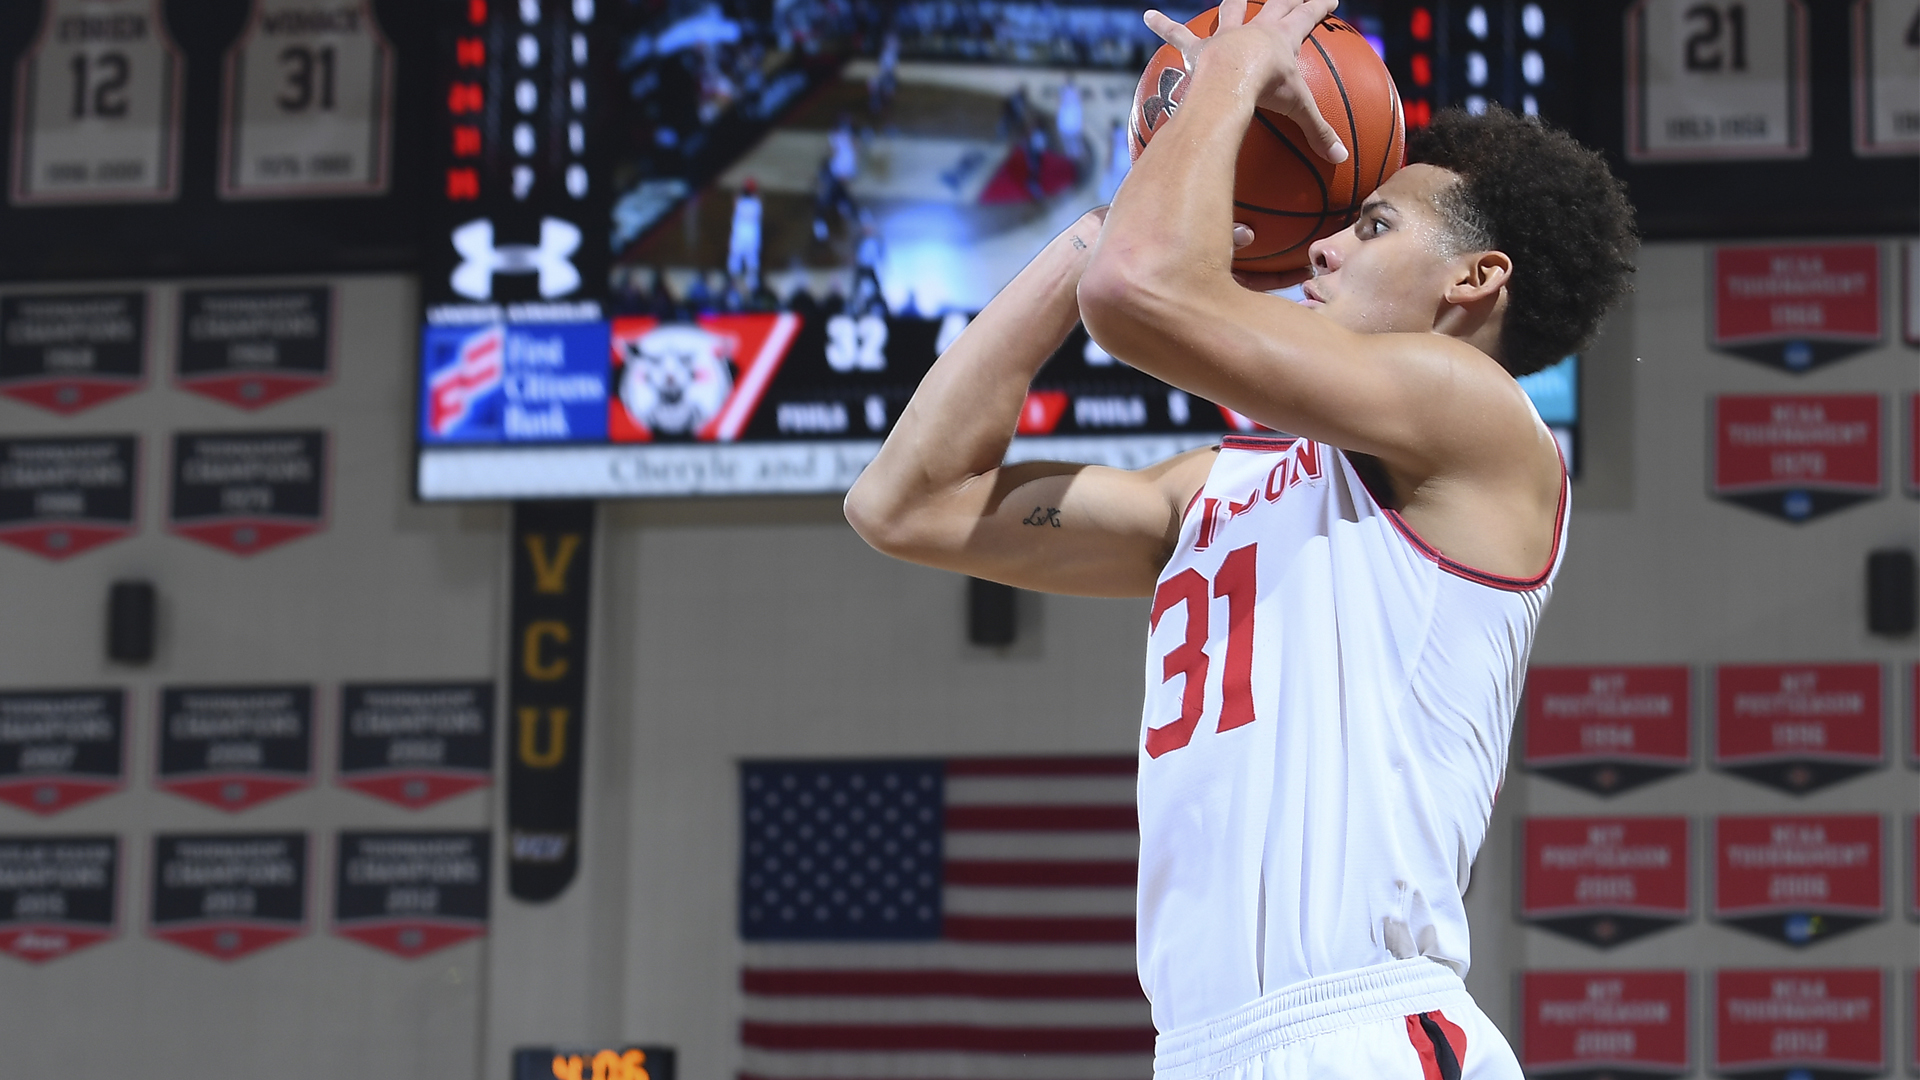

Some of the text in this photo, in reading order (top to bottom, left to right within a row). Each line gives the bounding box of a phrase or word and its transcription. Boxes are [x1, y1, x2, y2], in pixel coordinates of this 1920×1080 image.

[1684, 4, 1747, 74] 21
[70, 52, 130, 121] 12
[277, 46, 336, 112] 31
[512, 164, 535, 201] 7
[507, 334, 564, 366] First
[825, 315, 888, 372] 32
[505, 371, 604, 404] Citizens
[504, 404, 571, 437] Bank
[608, 453, 739, 492] Cheryle
[758, 452, 819, 482] and
[517, 533, 581, 769] VCU
[1144, 542, 1257, 760] 31
[1581, 725, 1635, 748] 1994
[1727, 844, 1870, 867] TOURNAMENT
[1727, 999, 1871, 1022] TOURNAMENT
